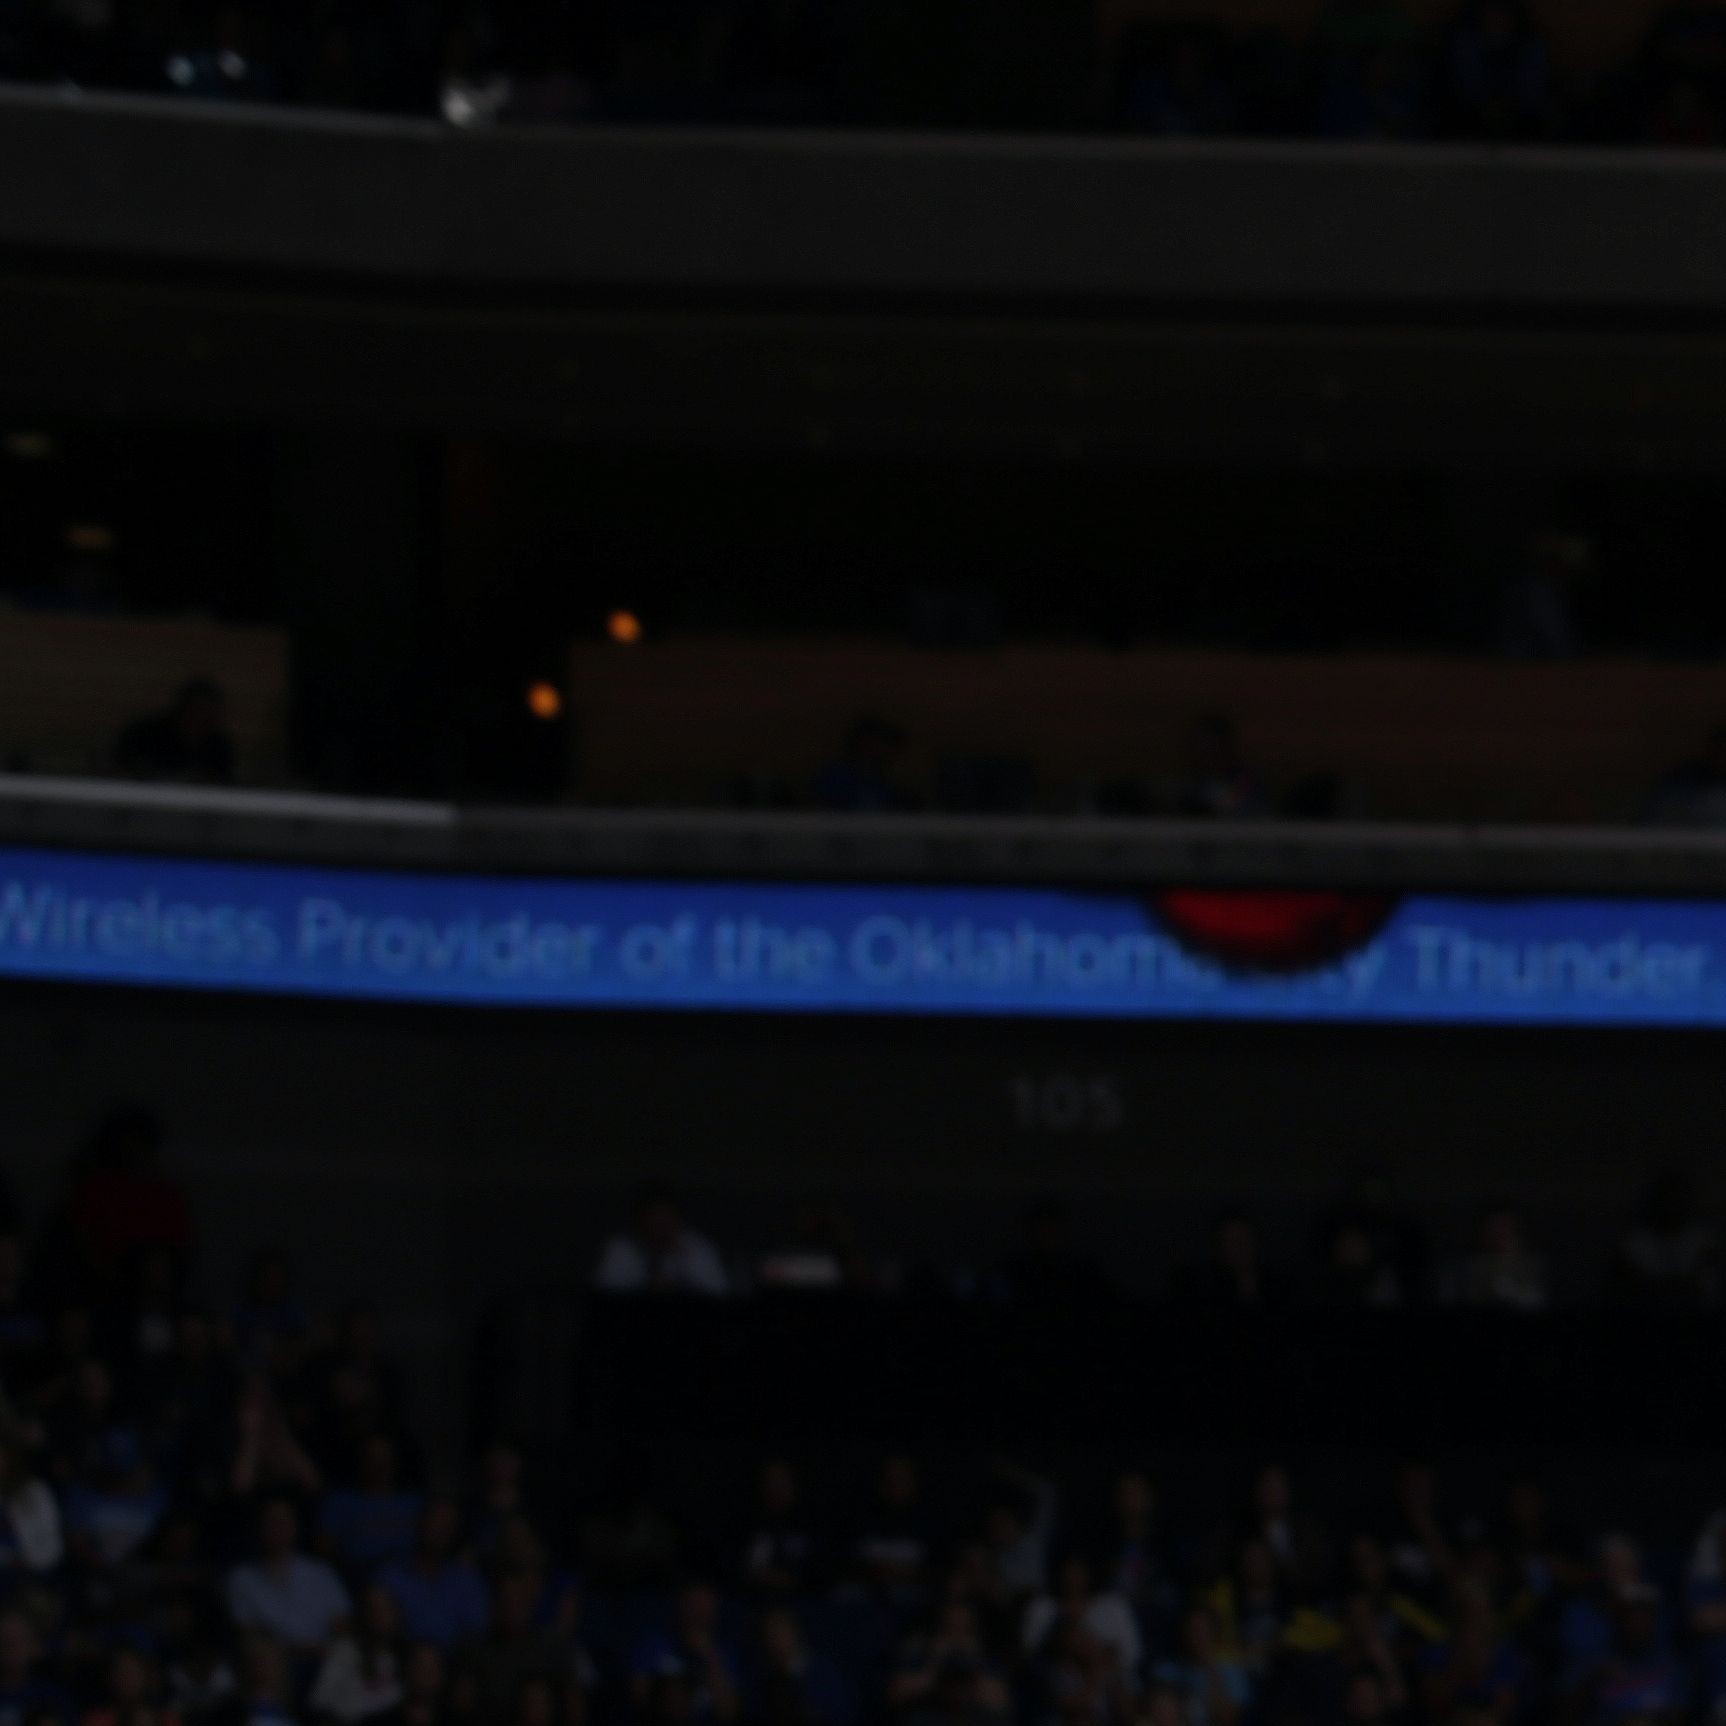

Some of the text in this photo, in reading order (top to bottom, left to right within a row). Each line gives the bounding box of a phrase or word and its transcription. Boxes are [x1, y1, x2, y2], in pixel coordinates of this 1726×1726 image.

[0, 884, 281, 966] Wireless
[297, 894, 597, 981] Provider
[617, 911, 694, 984] of
[713, 914, 834, 984] the
[1405, 923, 1704, 997] Thunder
[1012, 1071, 1124, 1131] 105
